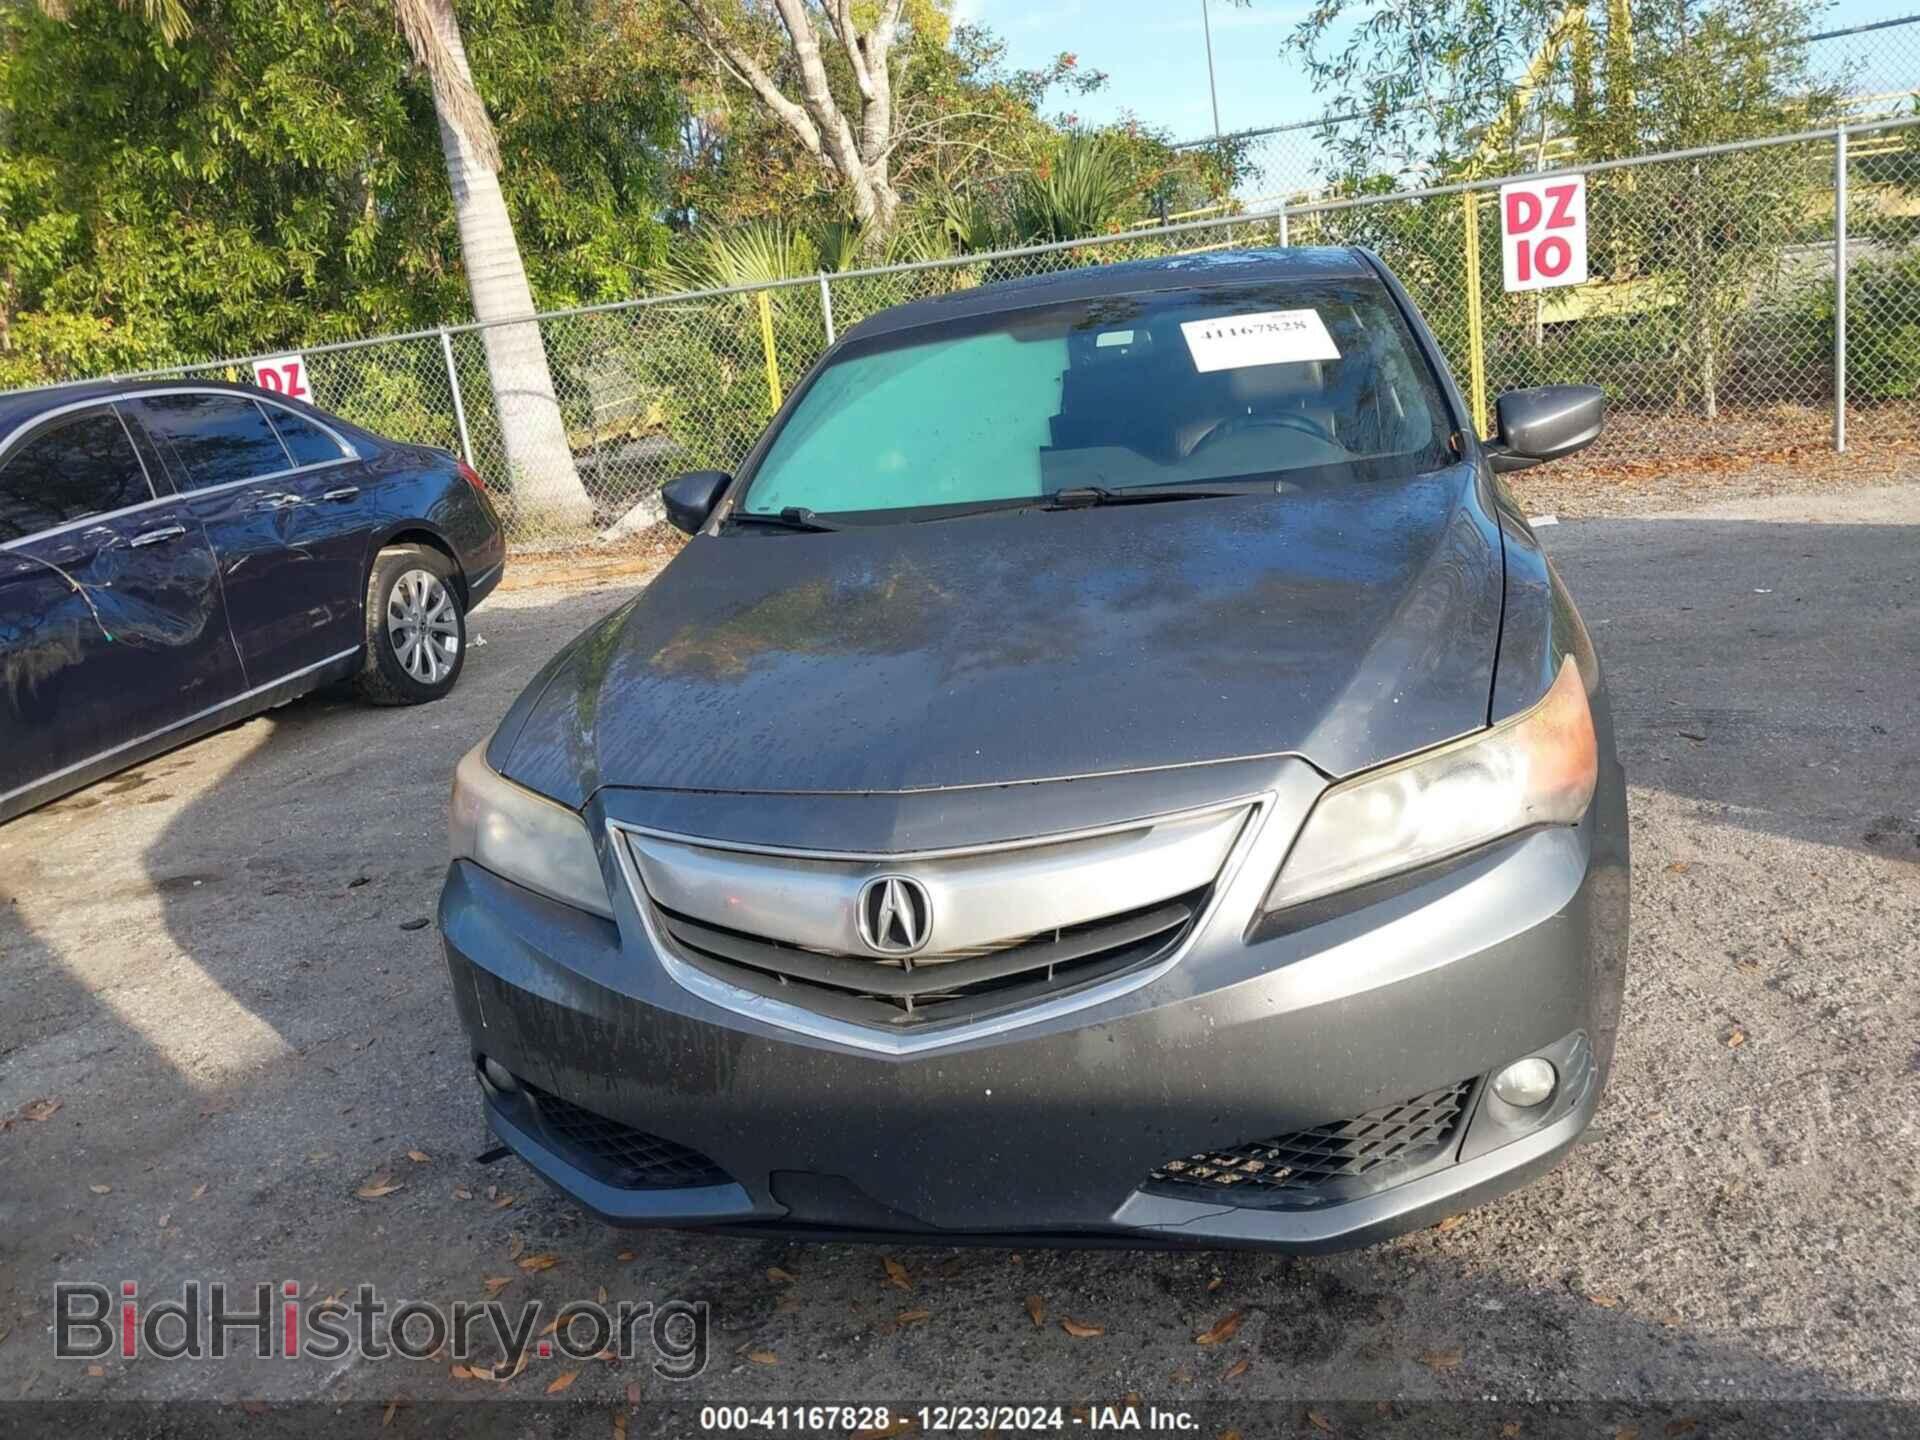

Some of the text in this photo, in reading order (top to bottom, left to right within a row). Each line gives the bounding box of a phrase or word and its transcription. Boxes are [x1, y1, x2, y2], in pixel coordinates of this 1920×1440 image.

[1506, 184, 1578, 235] DZ
[1201, 320, 1307, 340] 41167828
[258, 363, 306, 397] DZ
